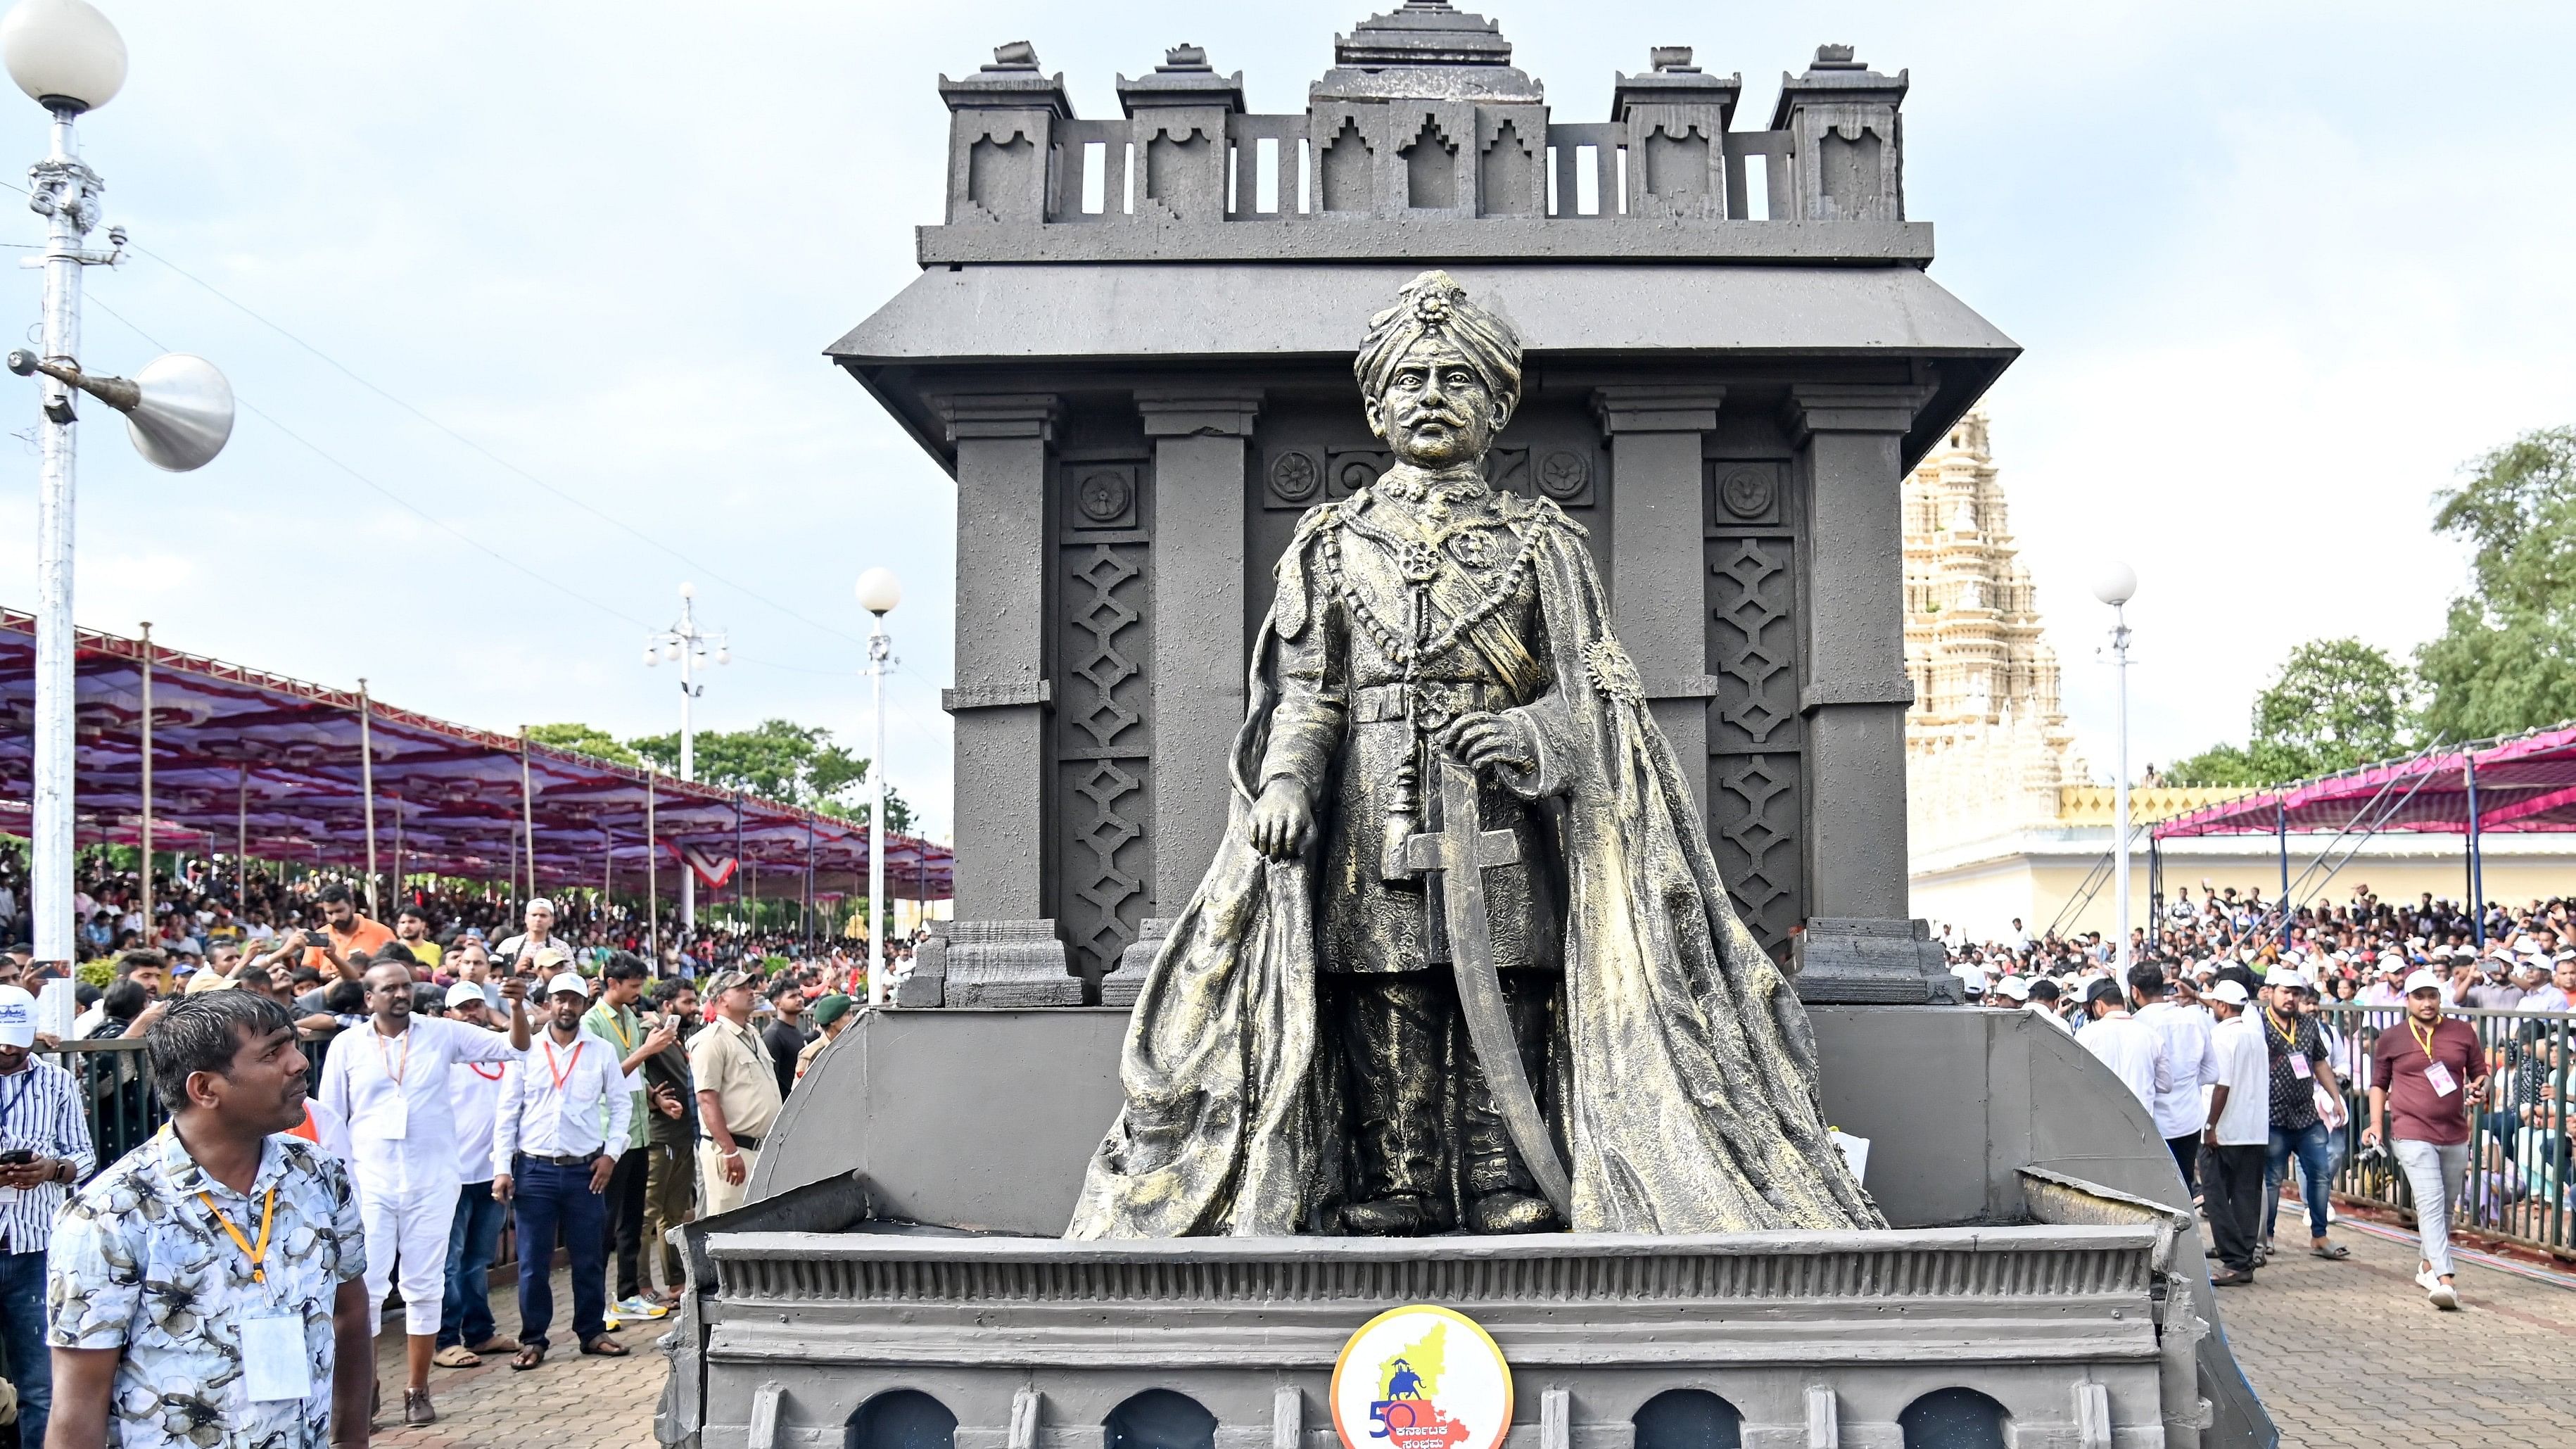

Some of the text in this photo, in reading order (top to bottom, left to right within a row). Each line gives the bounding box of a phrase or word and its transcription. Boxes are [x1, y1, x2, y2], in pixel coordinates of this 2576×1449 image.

[1369, 1400, 1416, 1438] 50
[1395, 1425, 1448, 1436] ಕರ್ನಾಟಕ
[1402, 1438, 1444, 1449] ಸಂಭ್ಮ
